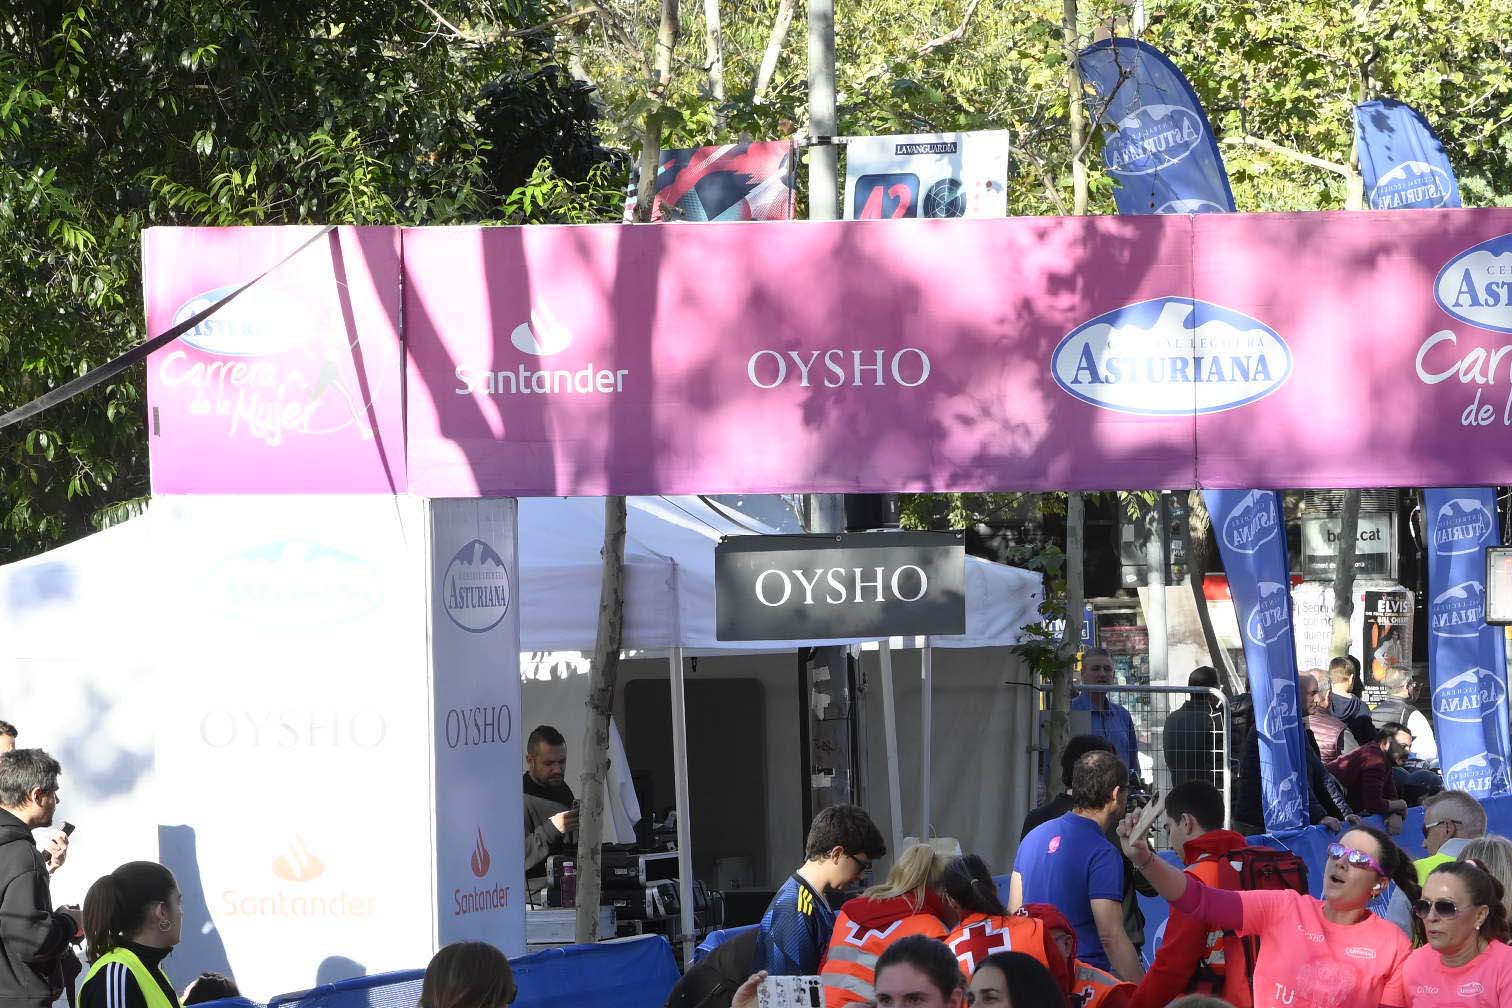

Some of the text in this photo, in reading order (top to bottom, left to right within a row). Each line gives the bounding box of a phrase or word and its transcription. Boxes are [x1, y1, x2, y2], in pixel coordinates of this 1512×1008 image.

[454, 363, 629, 395] Santander
[747, 346, 931, 390] OYSHO
[1070, 341, 1273, 385] ASTURIANA
[1461, 389, 1496, 426] de
[448, 575, 507, 609] ASTURIANA
[754, 565, 929, 607] OYSHO
[1378, 600, 1408, 613] ELVIS
[200, 705, 389, 750] OYSHO
[446, 704, 513, 749] OYSHO
[223, 888, 374, 919] Santander
[454, 884, 511, 916] Santander
[1275, 982, 1295, 1005] TU
